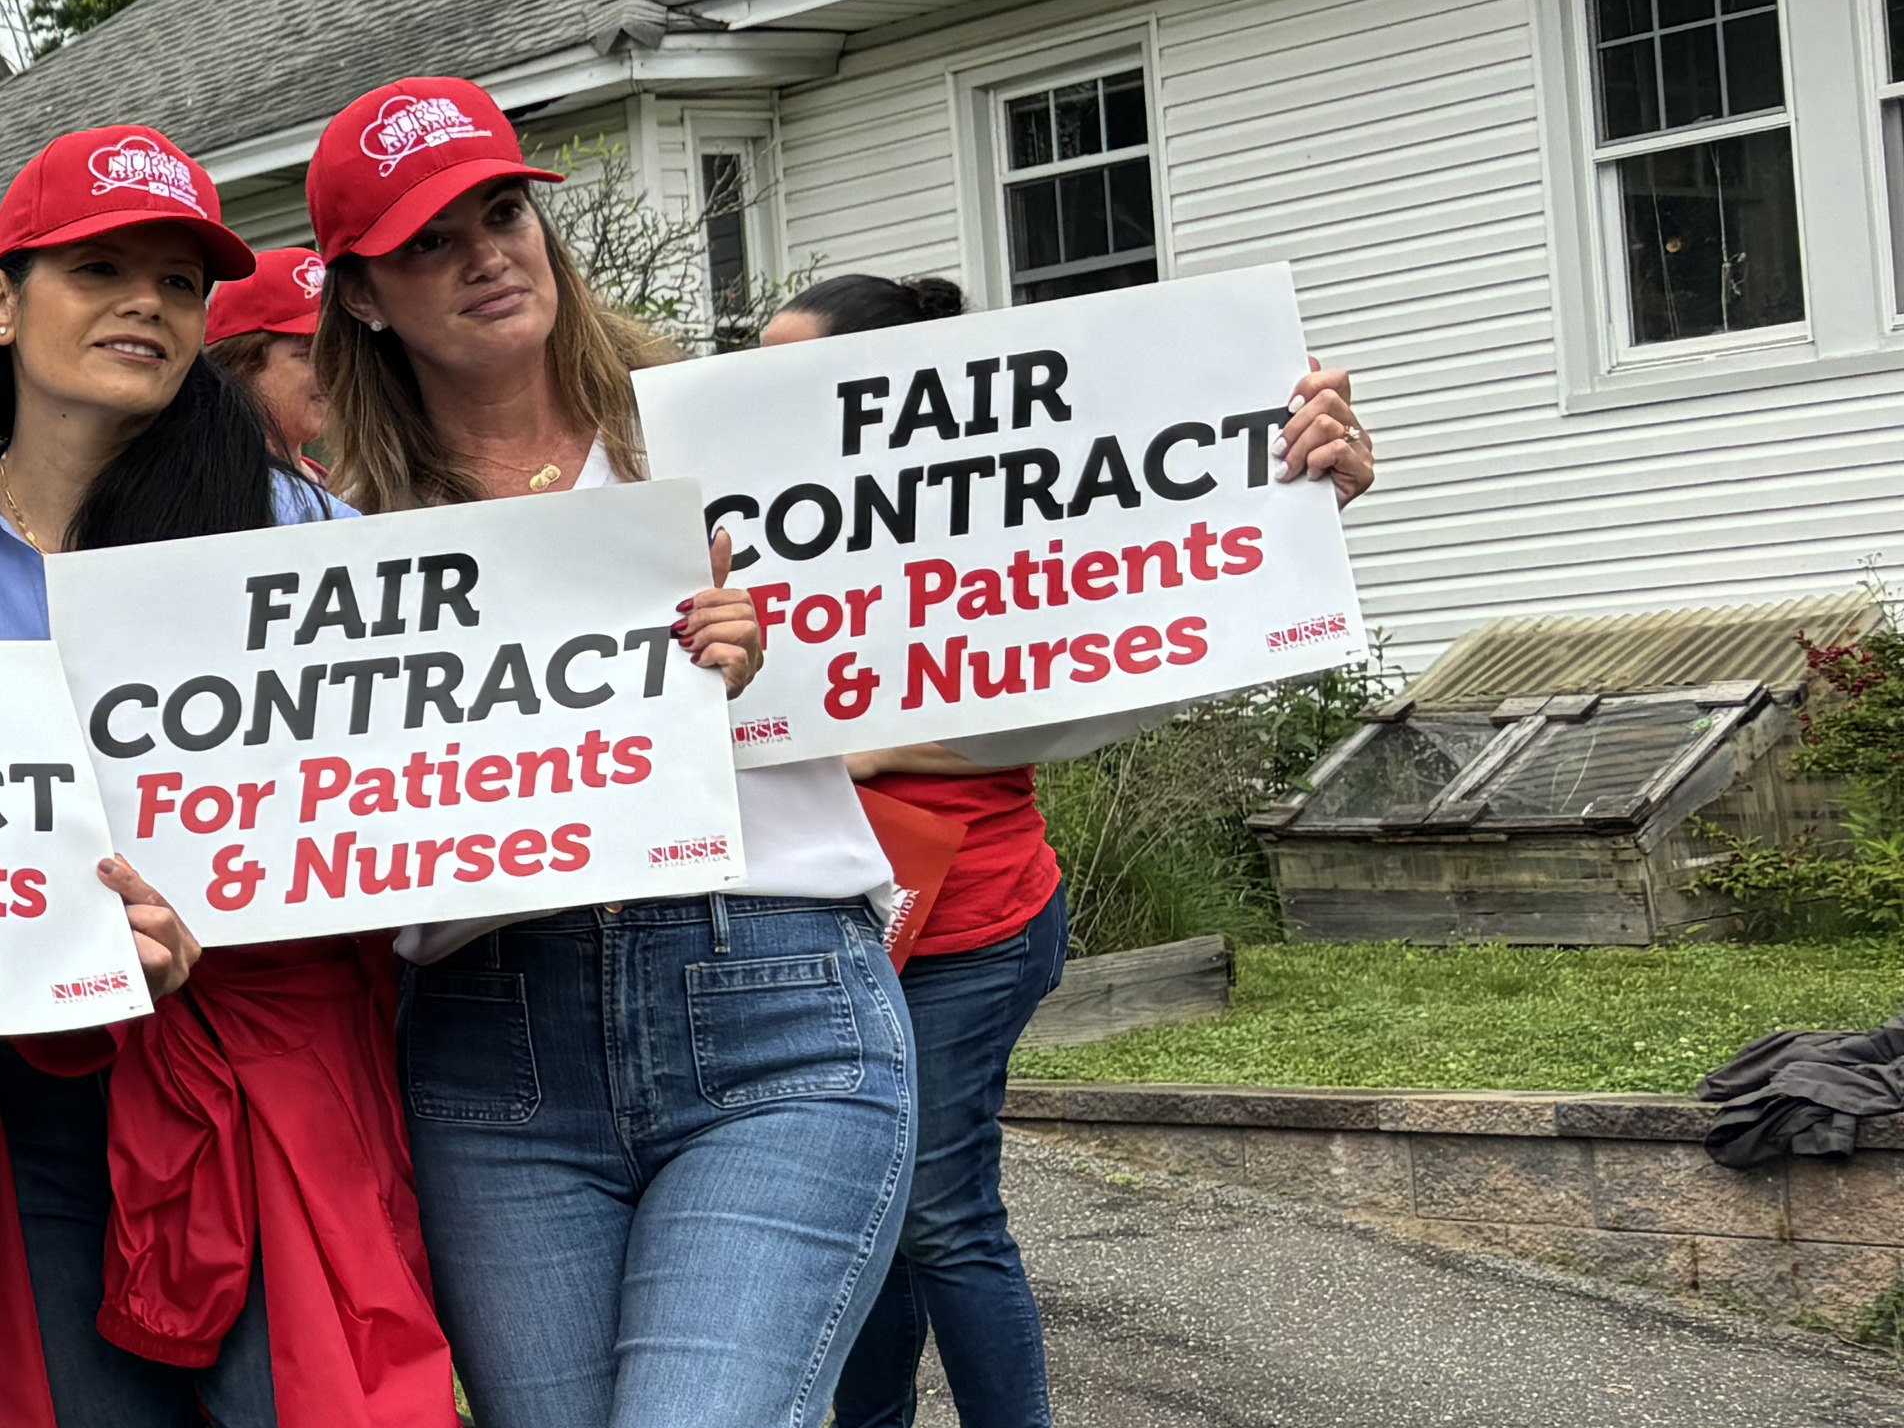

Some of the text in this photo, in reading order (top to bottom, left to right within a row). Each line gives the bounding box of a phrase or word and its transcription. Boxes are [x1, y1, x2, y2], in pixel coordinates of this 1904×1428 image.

[837, 350, 1071, 456] FAIR
[704, 406, 1294, 572] CONTRACT
[246, 553, 479, 650] FAIR
[748, 524, 1262, 650] For Patients
[1266, 615, 1346, 649] NURSES
[90, 625, 679, 758] CONTRACT
[826, 618, 1208, 720] & Nurses
[138, 732, 652, 838] For Patients
[208, 824, 590, 911] & Nurses
[648, 838, 729, 864] NURSES
[51, 973, 131, 1001] NURSES
